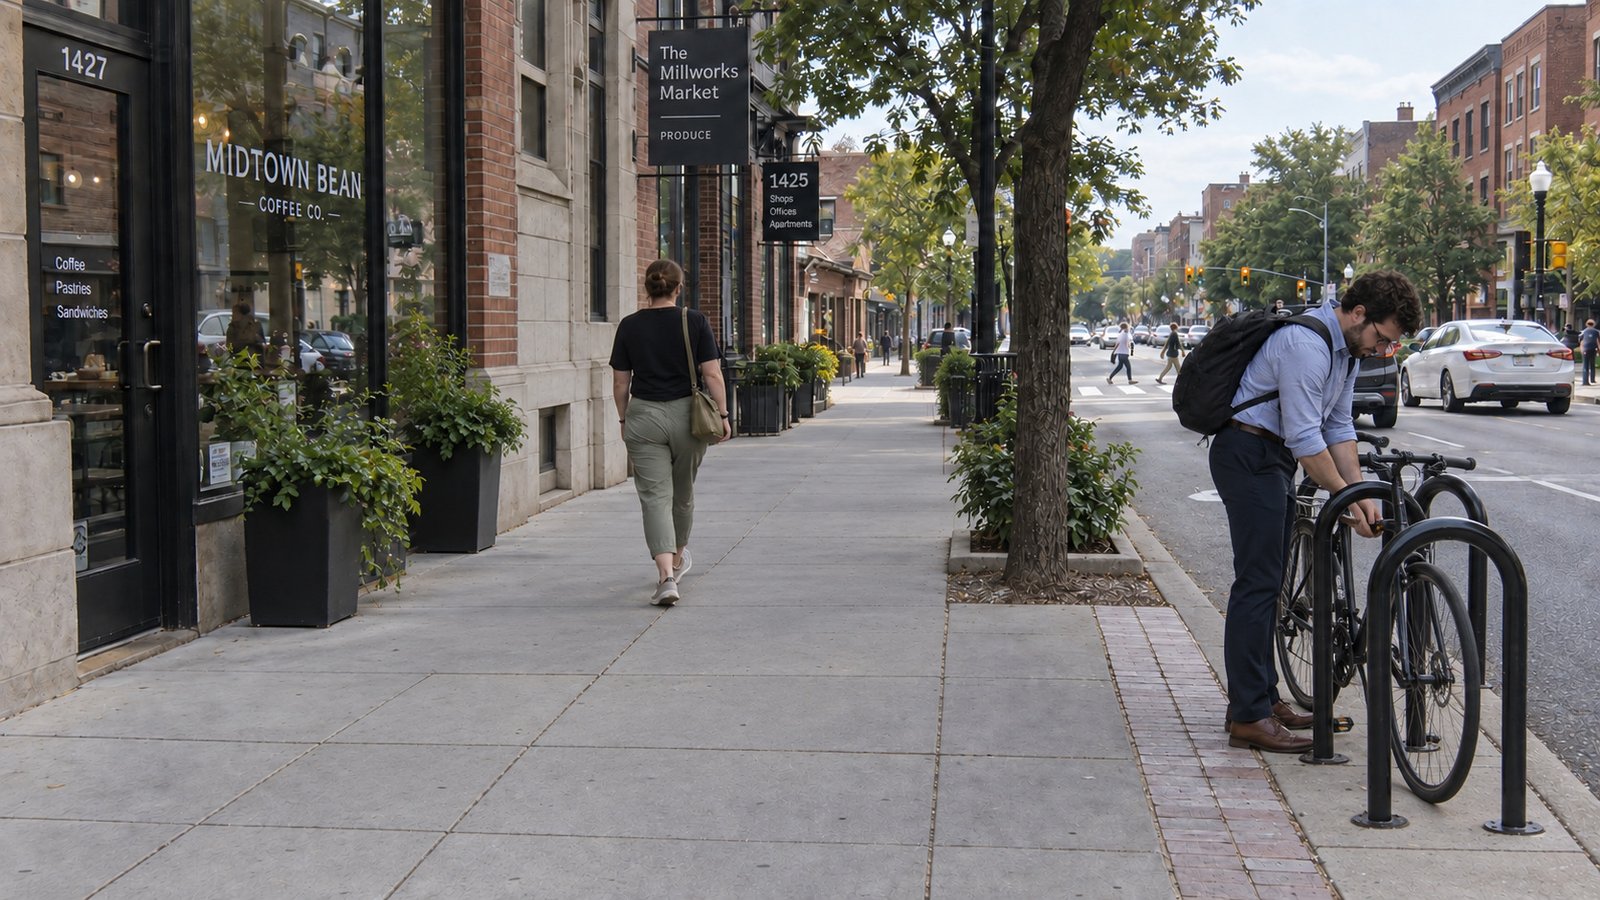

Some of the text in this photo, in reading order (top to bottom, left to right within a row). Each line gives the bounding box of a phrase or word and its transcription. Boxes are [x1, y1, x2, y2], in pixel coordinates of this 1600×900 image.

[660, 45, 688, 60] The
[61, 46, 108, 80] 1427
[660, 62, 739, 81] Millworks
[660, 84, 720, 101] Market
[660, 130, 711, 141] PRODUCE
[205, 139, 362, 200] MIDTOWN BEAN
[769, 172, 809, 189] 1425
[769, 194, 794, 205] Shops
[258, 196, 325, 221] COFFEE CO.
[769, 207, 797, 217] Offices
[769, 219, 813, 231] Apartments
[55, 256, 86, 272] Coffee
[55, 280, 92, 296] Pastries
[56, 304, 109, 319] Sandwiches
